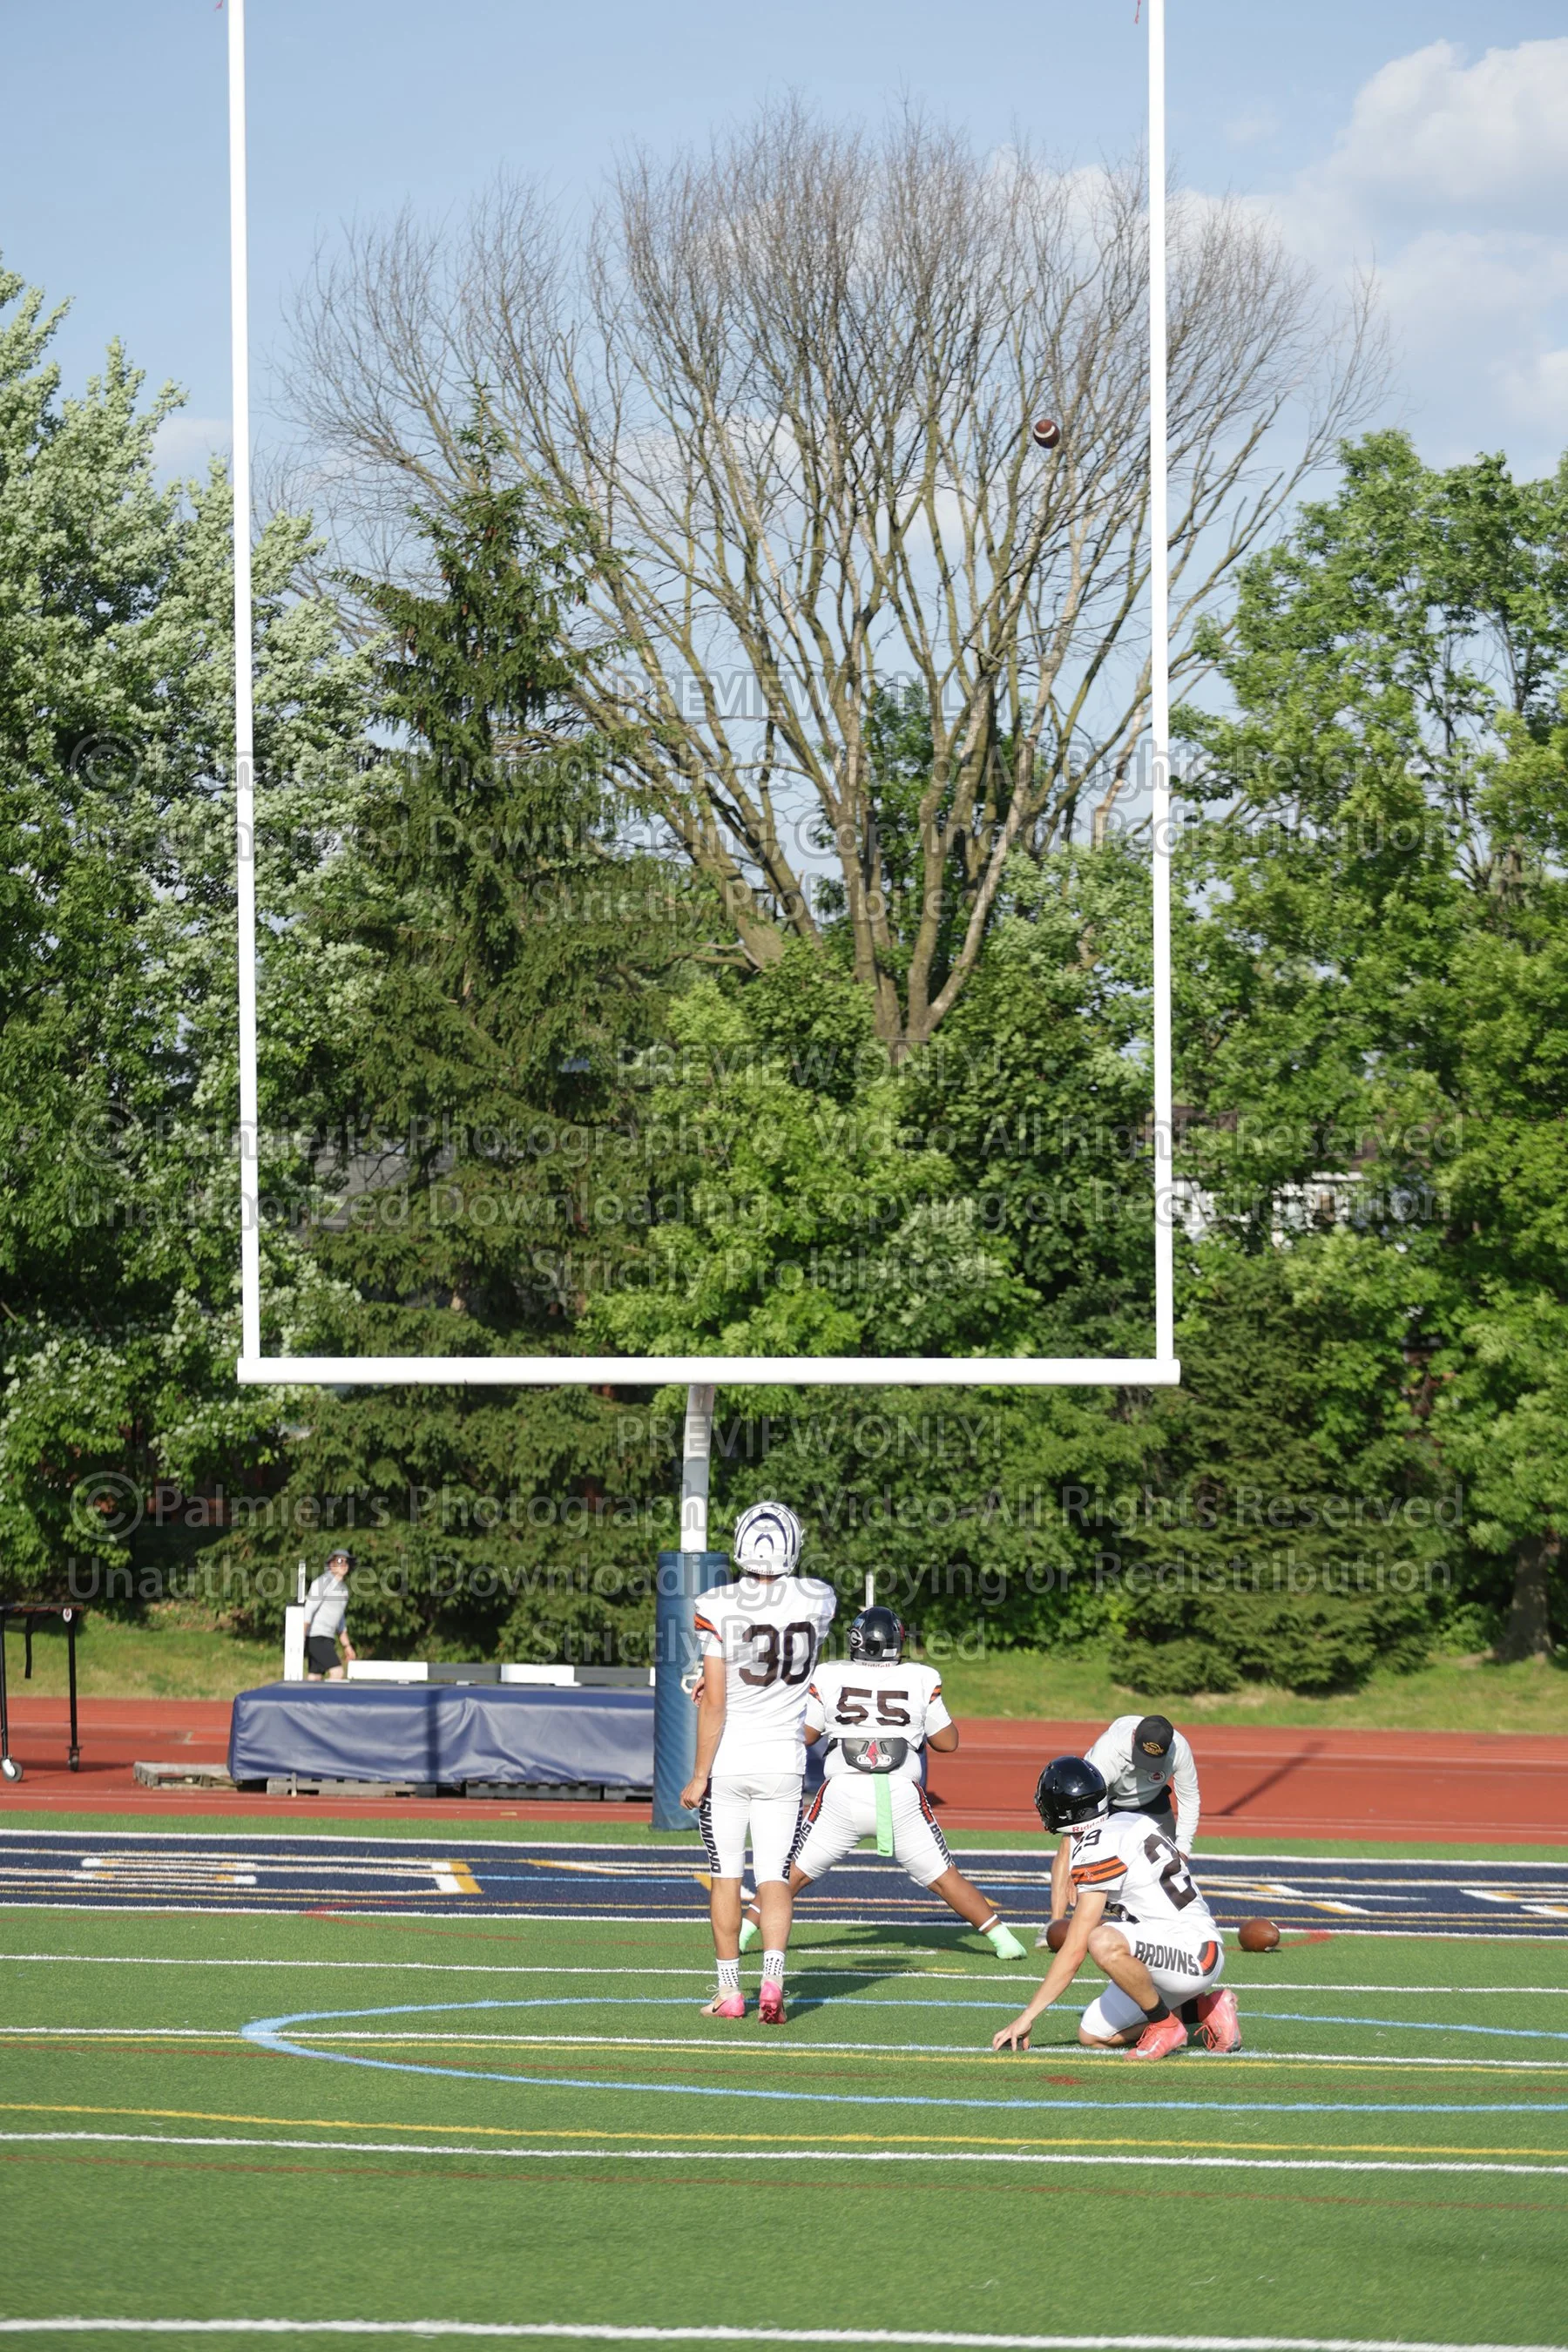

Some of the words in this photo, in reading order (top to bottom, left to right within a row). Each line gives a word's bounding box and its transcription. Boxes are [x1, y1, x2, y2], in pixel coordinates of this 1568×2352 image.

[739, 1621, 816, 1686] 30
[835, 1686, 910, 1727] 55
[1134, 1940, 1200, 1977] BROWNS
